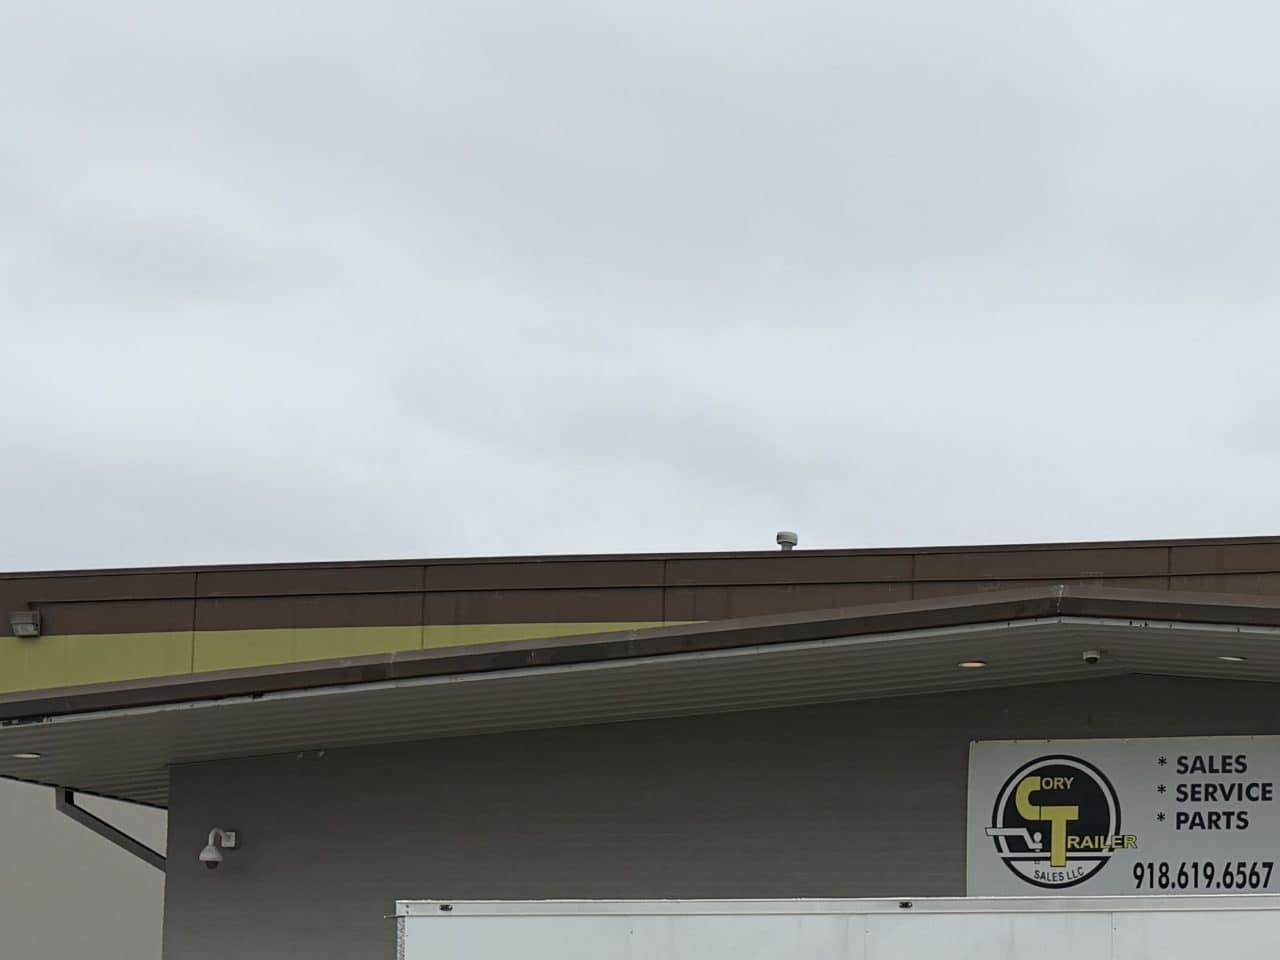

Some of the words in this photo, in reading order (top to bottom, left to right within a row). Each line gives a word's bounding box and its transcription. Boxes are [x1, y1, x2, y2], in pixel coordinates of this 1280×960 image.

[1175, 755, 1248, 774] SALES
[1175, 782, 1273, 802] SERVICE
[1175, 810, 1249, 831] PARTS
[1033, 869, 1064, 883] SALES
[1066, 866, 1085, 881] LLC
[1133, 861, 1274, 889] 918.619.6567
